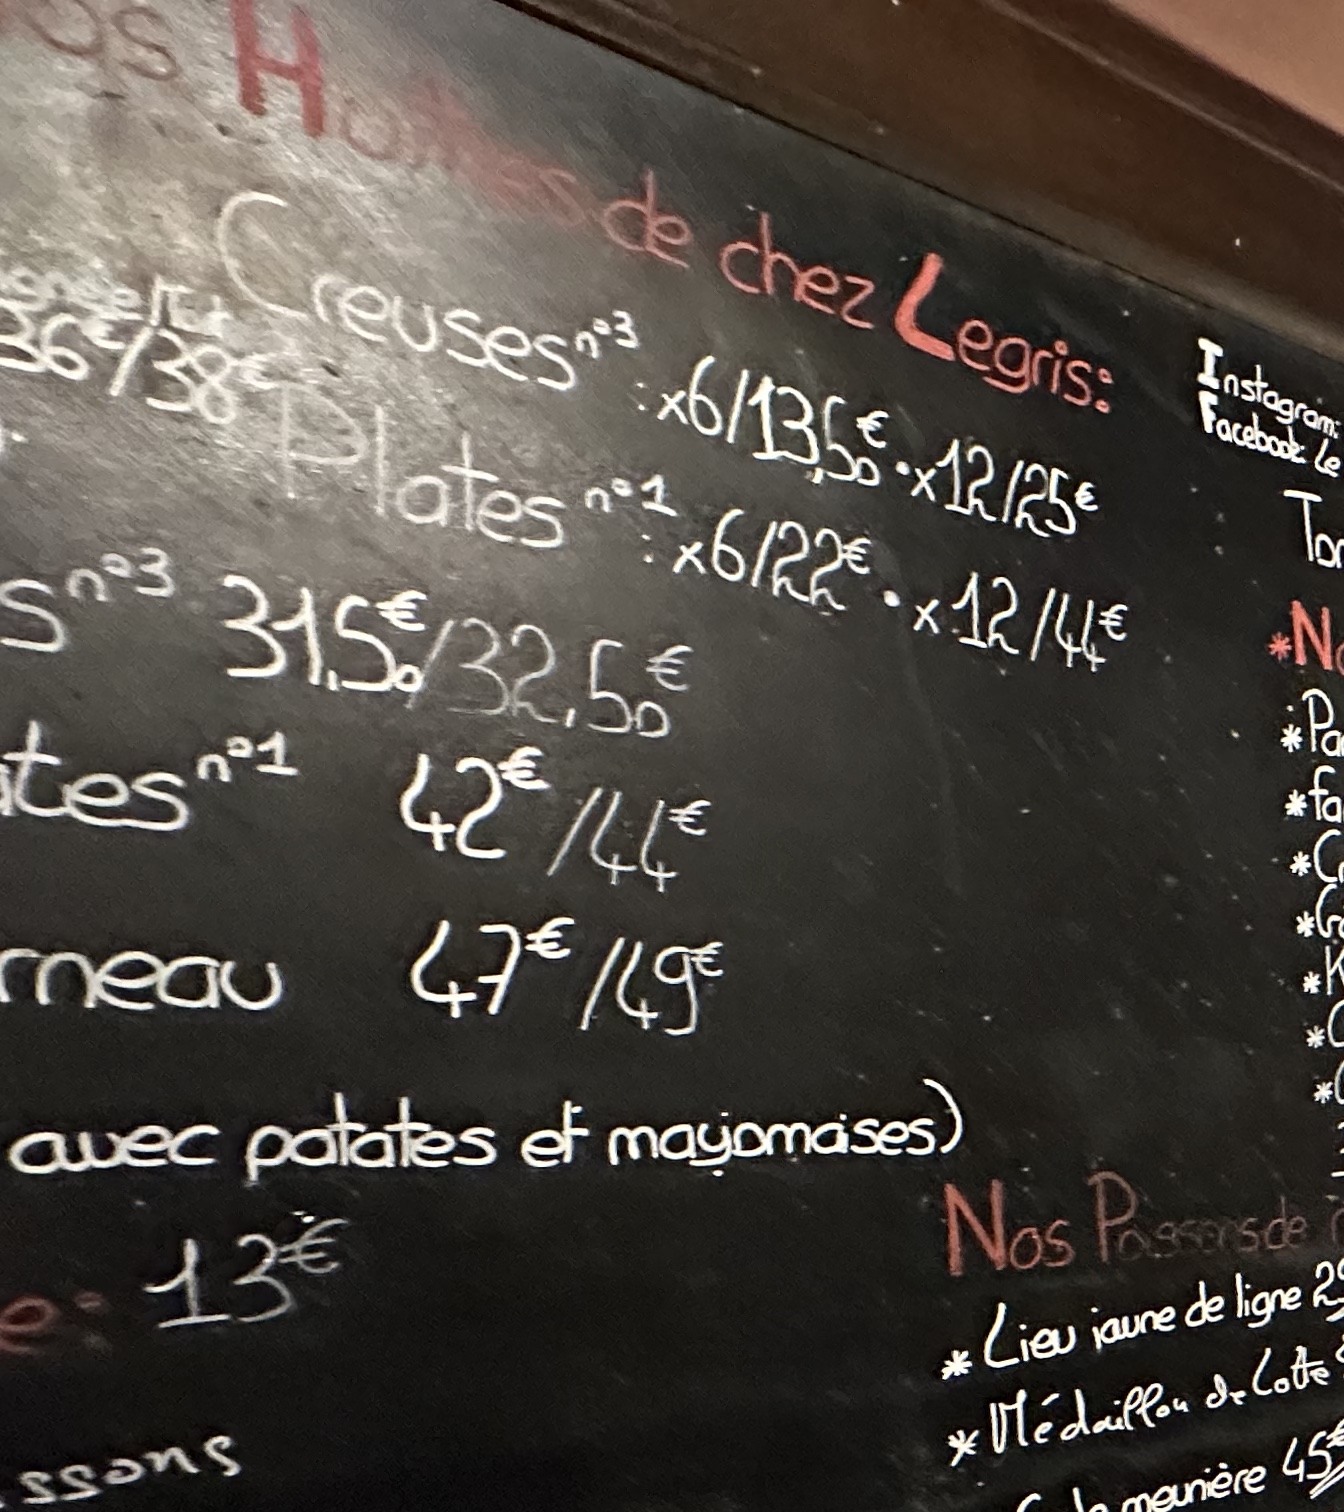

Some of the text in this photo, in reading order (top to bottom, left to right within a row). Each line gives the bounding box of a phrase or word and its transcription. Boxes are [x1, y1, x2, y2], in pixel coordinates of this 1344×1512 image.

[216, 190, 577, 392] Creuses
[600, 168, 694, 268] de
[718, 210, 874, 330] chez
[894, 252, 1113, 415] Legris:
[1197, 337, 1341, 440] Instagram:
[282, 378, 565, 548] Plates
[1314, 438, 1340, 480] Le
[400, 746, 548, 860] 42€
[408, 916, 576, 1018] 47€
[8, 1122, 218, 1174] avec
[246, 1092, 498, 1182] patates
[520, 1100, 590, 1168] et
[142, 1216, 346, 1330] 13€
[943, 1176, 1078, 1277] Nos
[983, 1302, 1077, 1370] Lieu
[1091, 1304, 1176, 1352] jaune
[1184, 1280, 1225, 1329] de
[1235, 1273, 1303, 1329] ligne
[989, 1388, 1190, 1456] Médaillon
[1204, 1373, 1247, 1411] de
[0, 1434, 242, 1512] ssons
